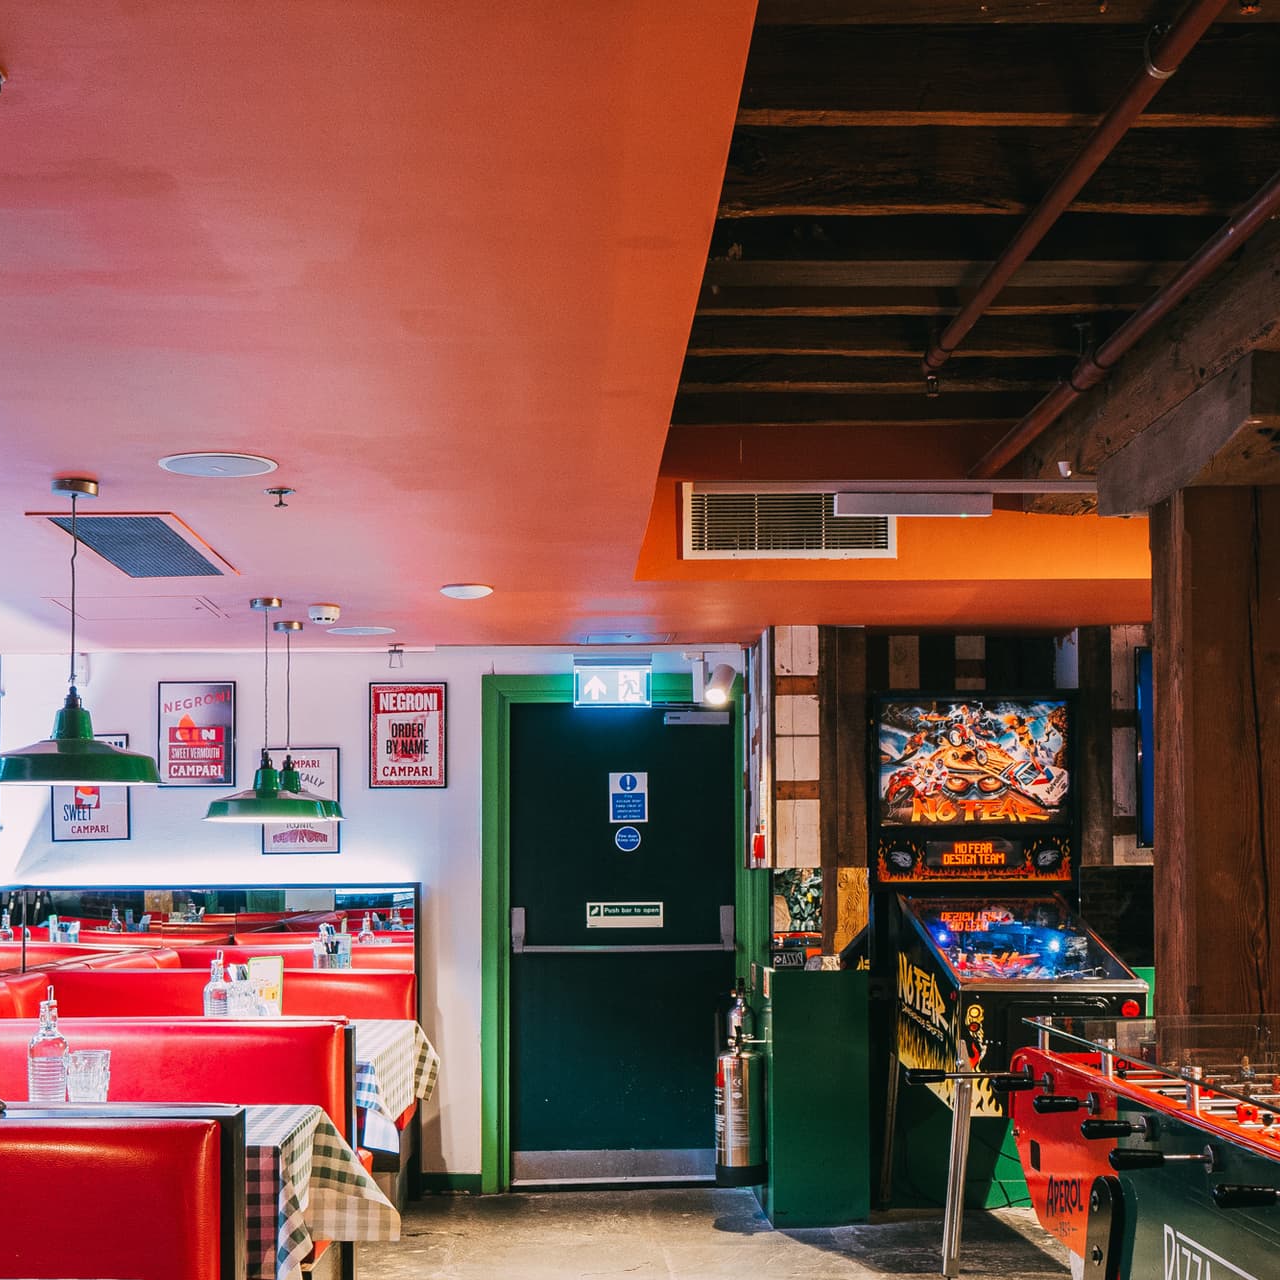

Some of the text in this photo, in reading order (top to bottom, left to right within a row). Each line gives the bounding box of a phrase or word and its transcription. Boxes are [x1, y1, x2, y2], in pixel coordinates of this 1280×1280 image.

[163, 688, 231, 713] NEGRONI
[379, 692, 438, 711] NEGRONI
[175, 729, 216, 741] GIN
[391, 722, 424, 738] ORDER
[171, 747, 220, 759] SWEET VERMOUTH
[386, 739, 430, 754] BY NAME
[170, 764, 223, 777] CAMPARI
[293, 759, 321, 769] MPARI
[382, 766, 433, 777] CAMPARI
[63, 804, 93, 821] SWEET
[911, 797, 1050, 823] NO FEAR
[71, 824, 110, 834] CAMPARI
[954, 842, 993, 853] NO FEAR
[942, 853, 1006, 865] DESIGN TEAM
[898, 951, 949, 1031] NO FEAR
[1046, 1174, 1084, 1217] APEROL
